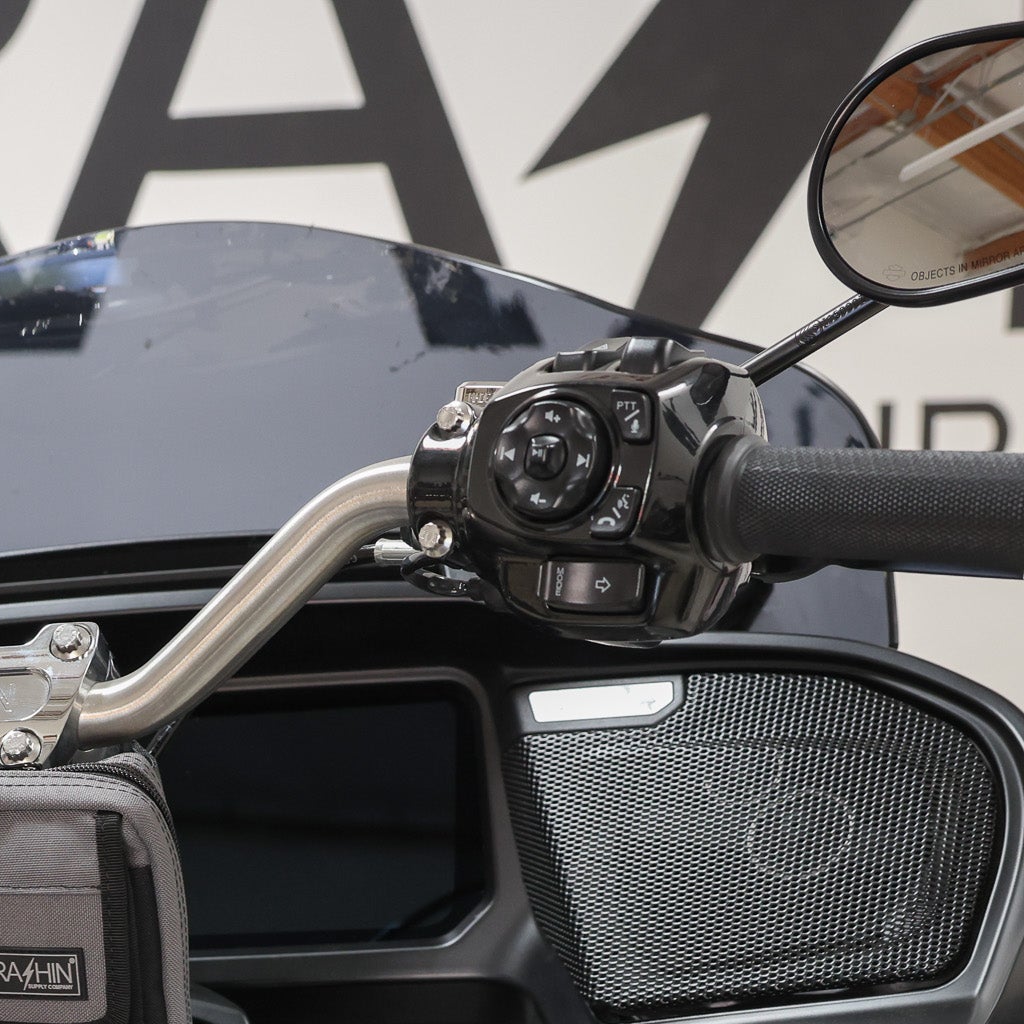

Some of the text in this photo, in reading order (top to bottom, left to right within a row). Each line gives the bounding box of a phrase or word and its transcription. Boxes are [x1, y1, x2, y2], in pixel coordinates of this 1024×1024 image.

[910, 266, 956, 282] OBJECTS
[958, 262, 969, 273] IN
[971, 251, 1011, 270] MIRROR
[616, 401, 637, 411] PTT
[555, 566, 565, 597] MODE
